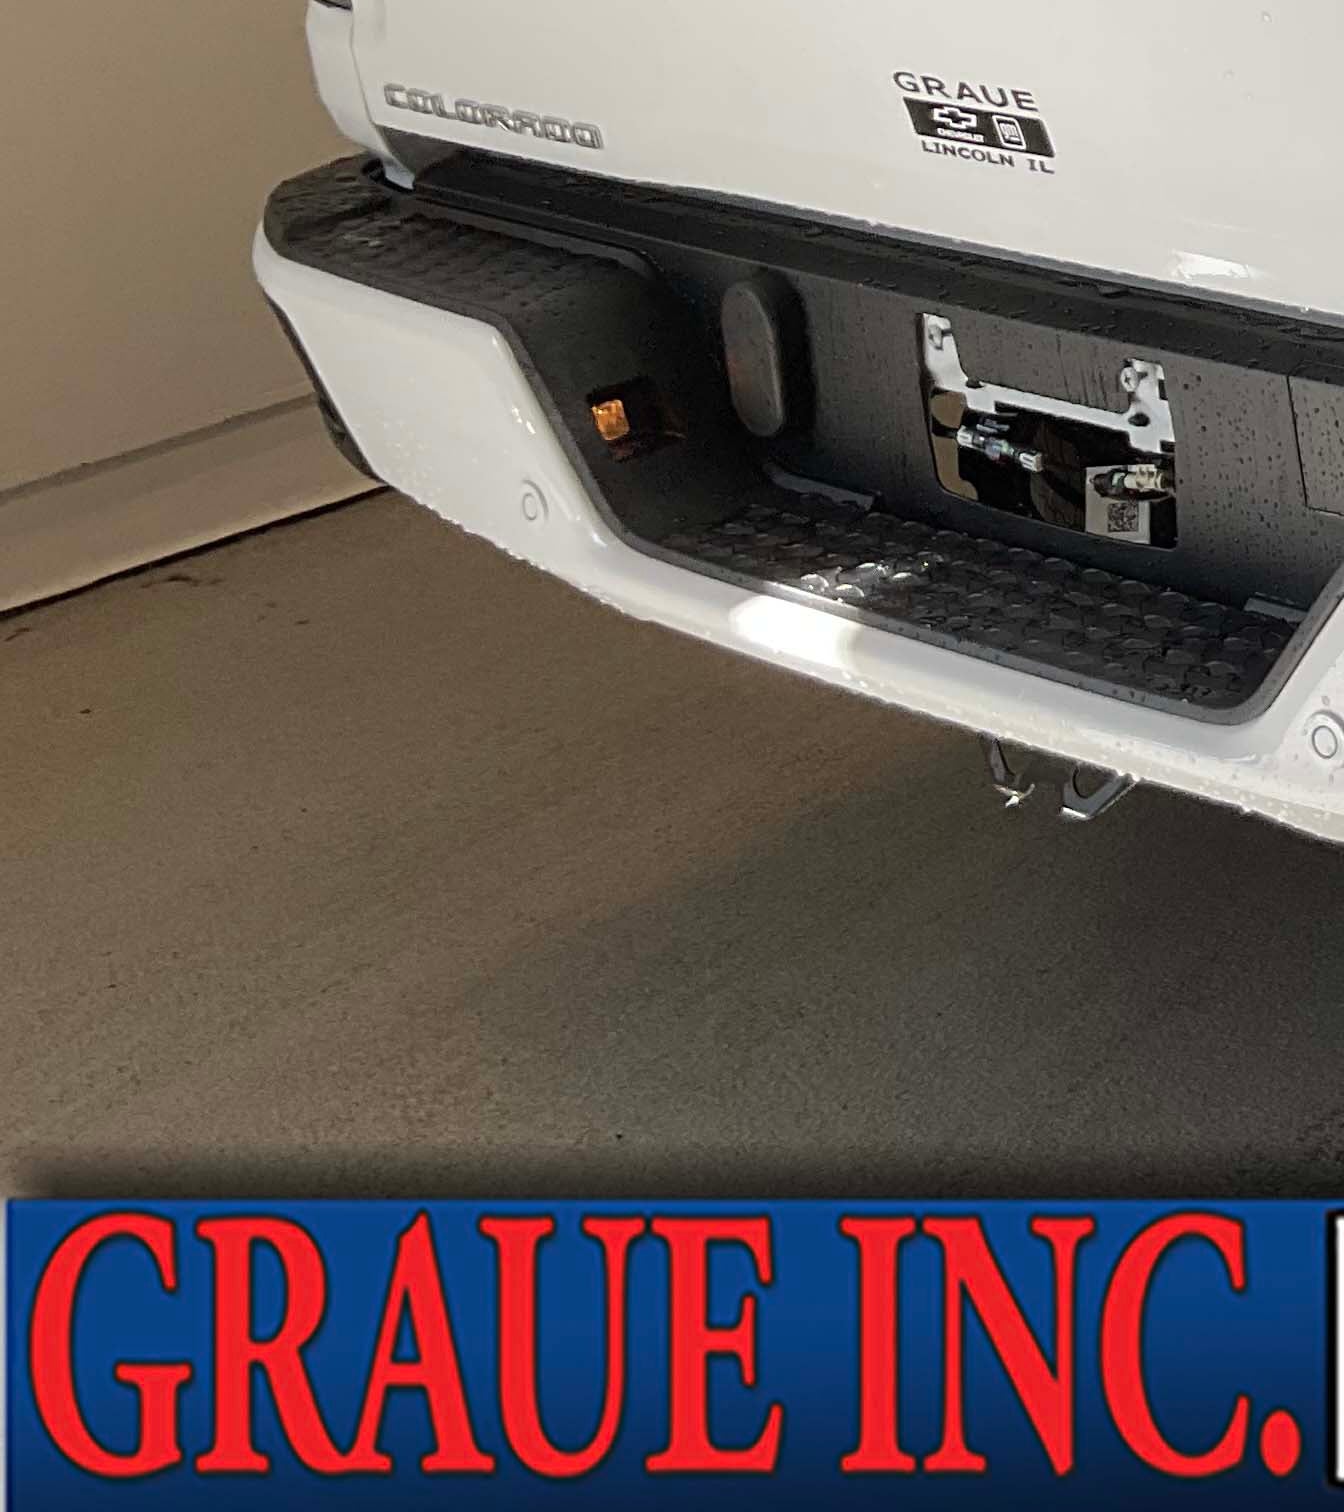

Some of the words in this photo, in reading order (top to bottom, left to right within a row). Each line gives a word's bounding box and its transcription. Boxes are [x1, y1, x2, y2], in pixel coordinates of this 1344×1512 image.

[892, 71, 1039, 112] GRAUE
[384, 83, 604, 149] COLORADO
[921, 140, 1015, 167] LINCOLN
[1027, 158, 1055, 174] IL
